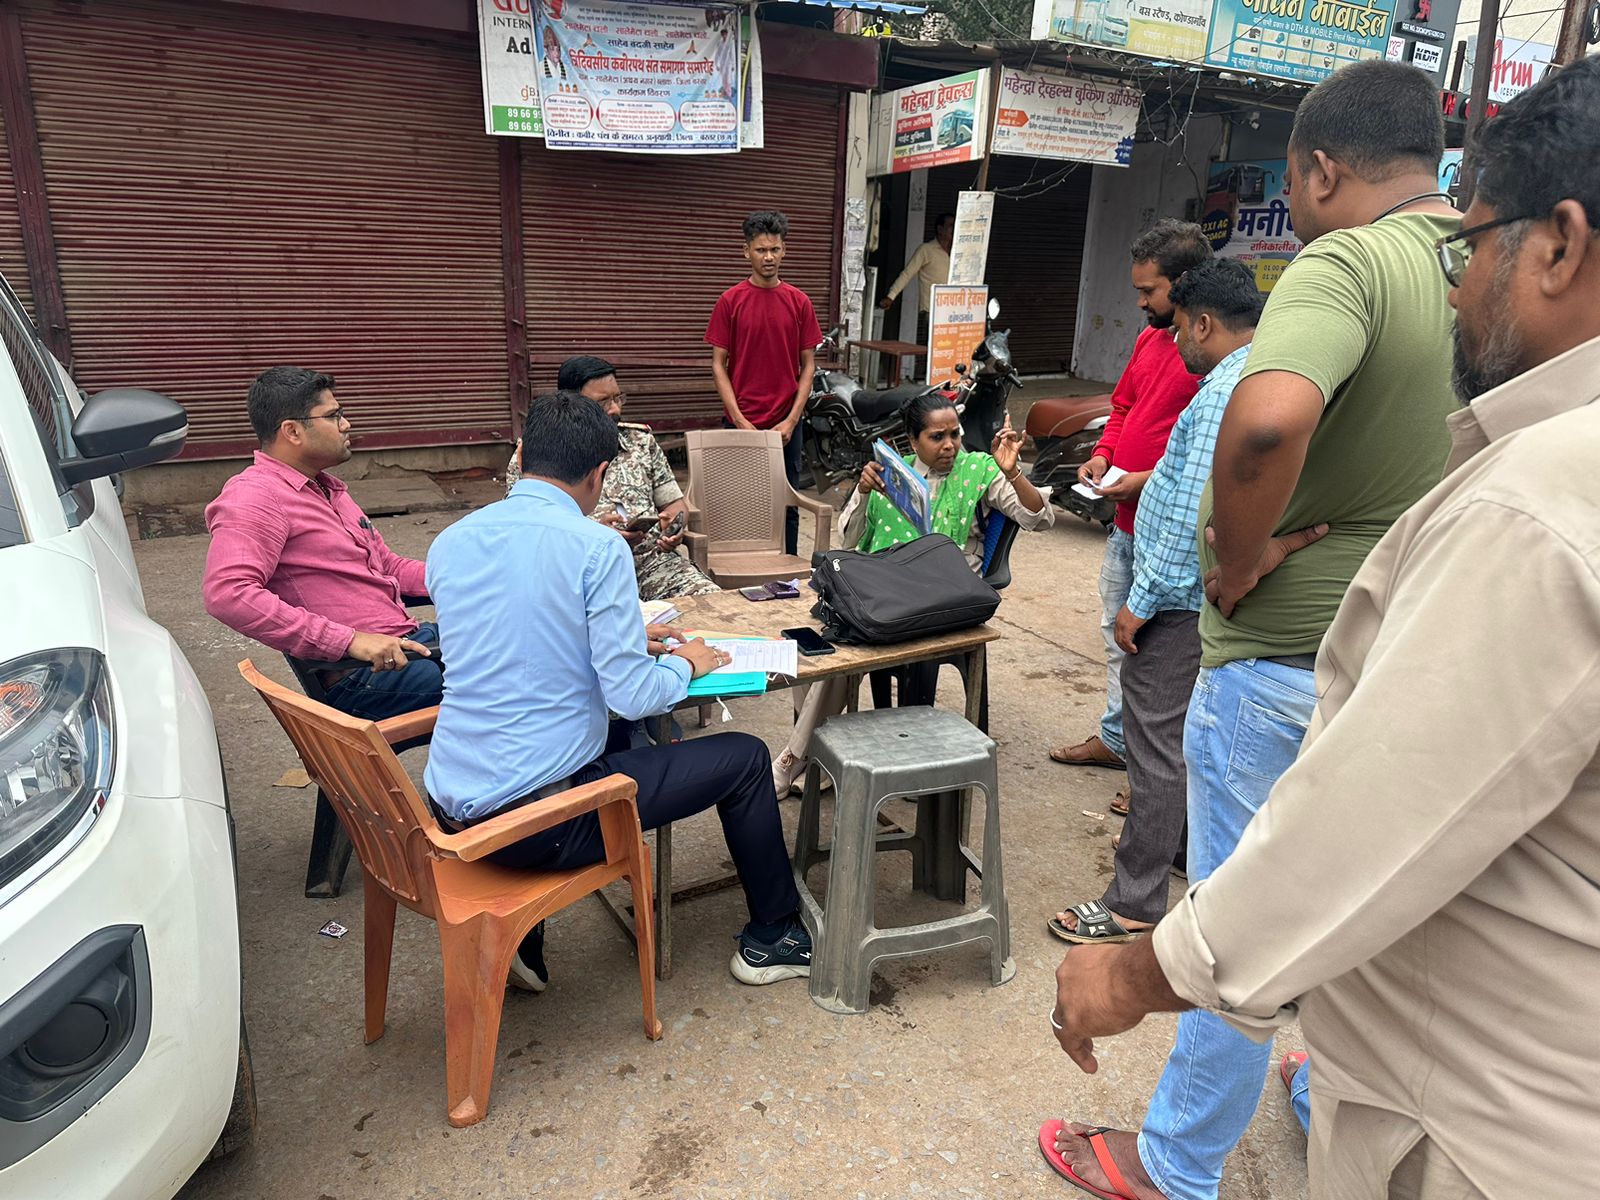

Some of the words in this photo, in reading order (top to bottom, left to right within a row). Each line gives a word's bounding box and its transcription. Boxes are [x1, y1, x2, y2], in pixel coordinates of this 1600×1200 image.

[1139, 6, 1151, 17] बस
[1290, 23, 1304, 32] DTH
[1310, 27, 1333, 37] MOBILE
[1415, 47, 1440, 64] KDM
[646, 55, 659, 74] संत
[660, 59, 686, 75] समागम
[507, 108, 518, 118] 89
[520, 108, 530, 118] 66
[508, 121, 518, 131] 89
[521, 121, 531, 131] 66
